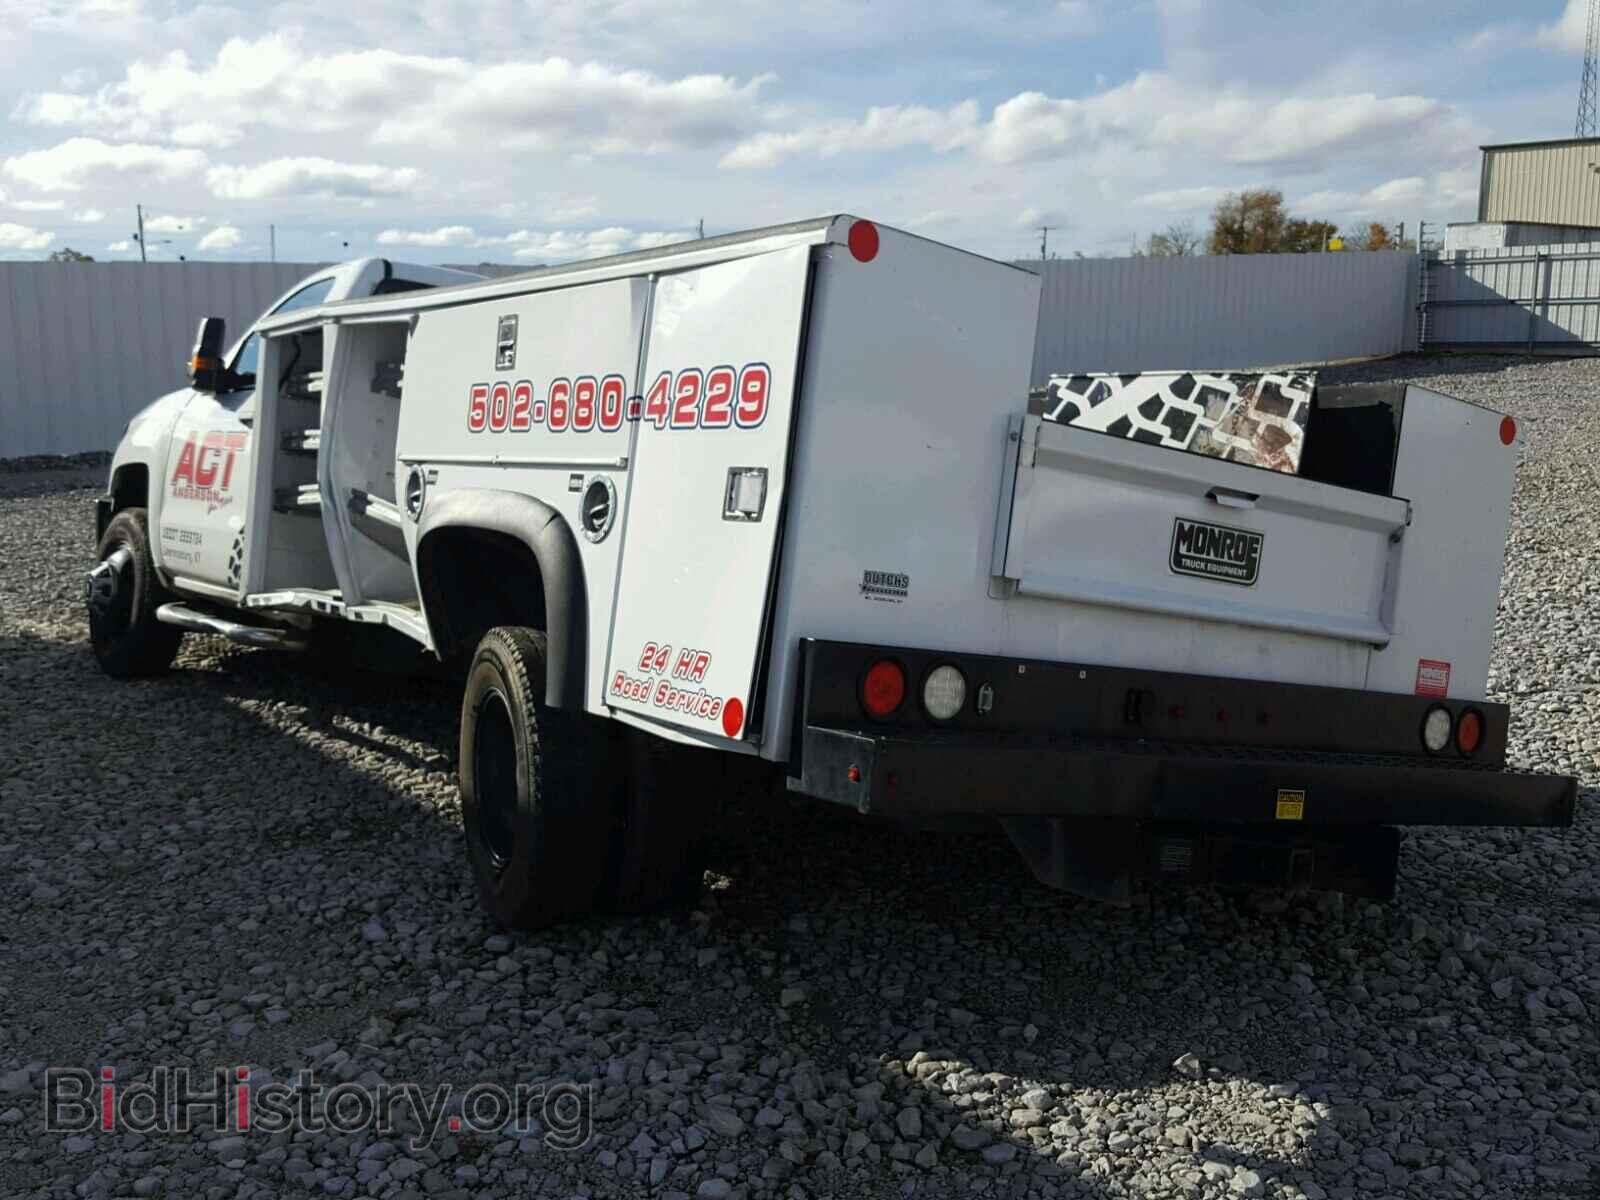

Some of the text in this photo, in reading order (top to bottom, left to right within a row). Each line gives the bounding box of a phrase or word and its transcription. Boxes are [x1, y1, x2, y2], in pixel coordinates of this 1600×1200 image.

[468, 362, 771, 432] 502-680-4229
[171, 432, 247, 490] ACT
[1177, 522, 1260, 564] MONROE
[1181, 558, 1248, 577] TRUCK EQUIPMENT
[639, 641, 711, 682] 24 HR
[610, 670, 723, 720] Road Service
